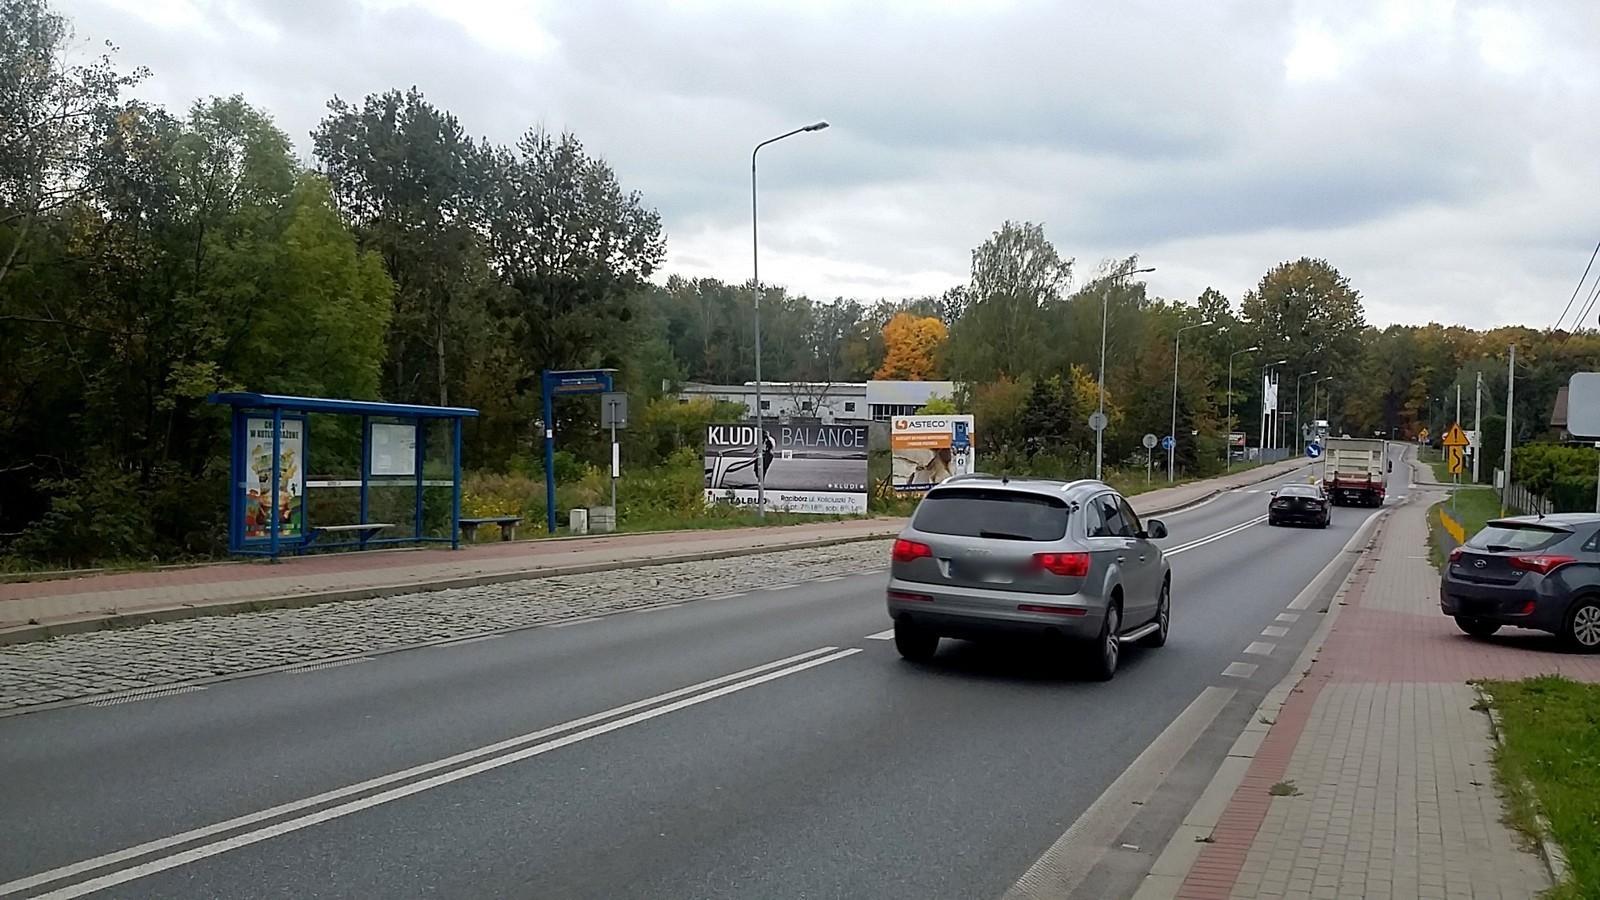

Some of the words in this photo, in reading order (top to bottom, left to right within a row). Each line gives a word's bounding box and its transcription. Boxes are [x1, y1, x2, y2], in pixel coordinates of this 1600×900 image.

[908, 420, 946, 428] ASTECO
[708, 426, 758, 446] KLUDI
[781, 427, 865, 448] BALANCE
[780, 494, 808, 502] Racibórz
